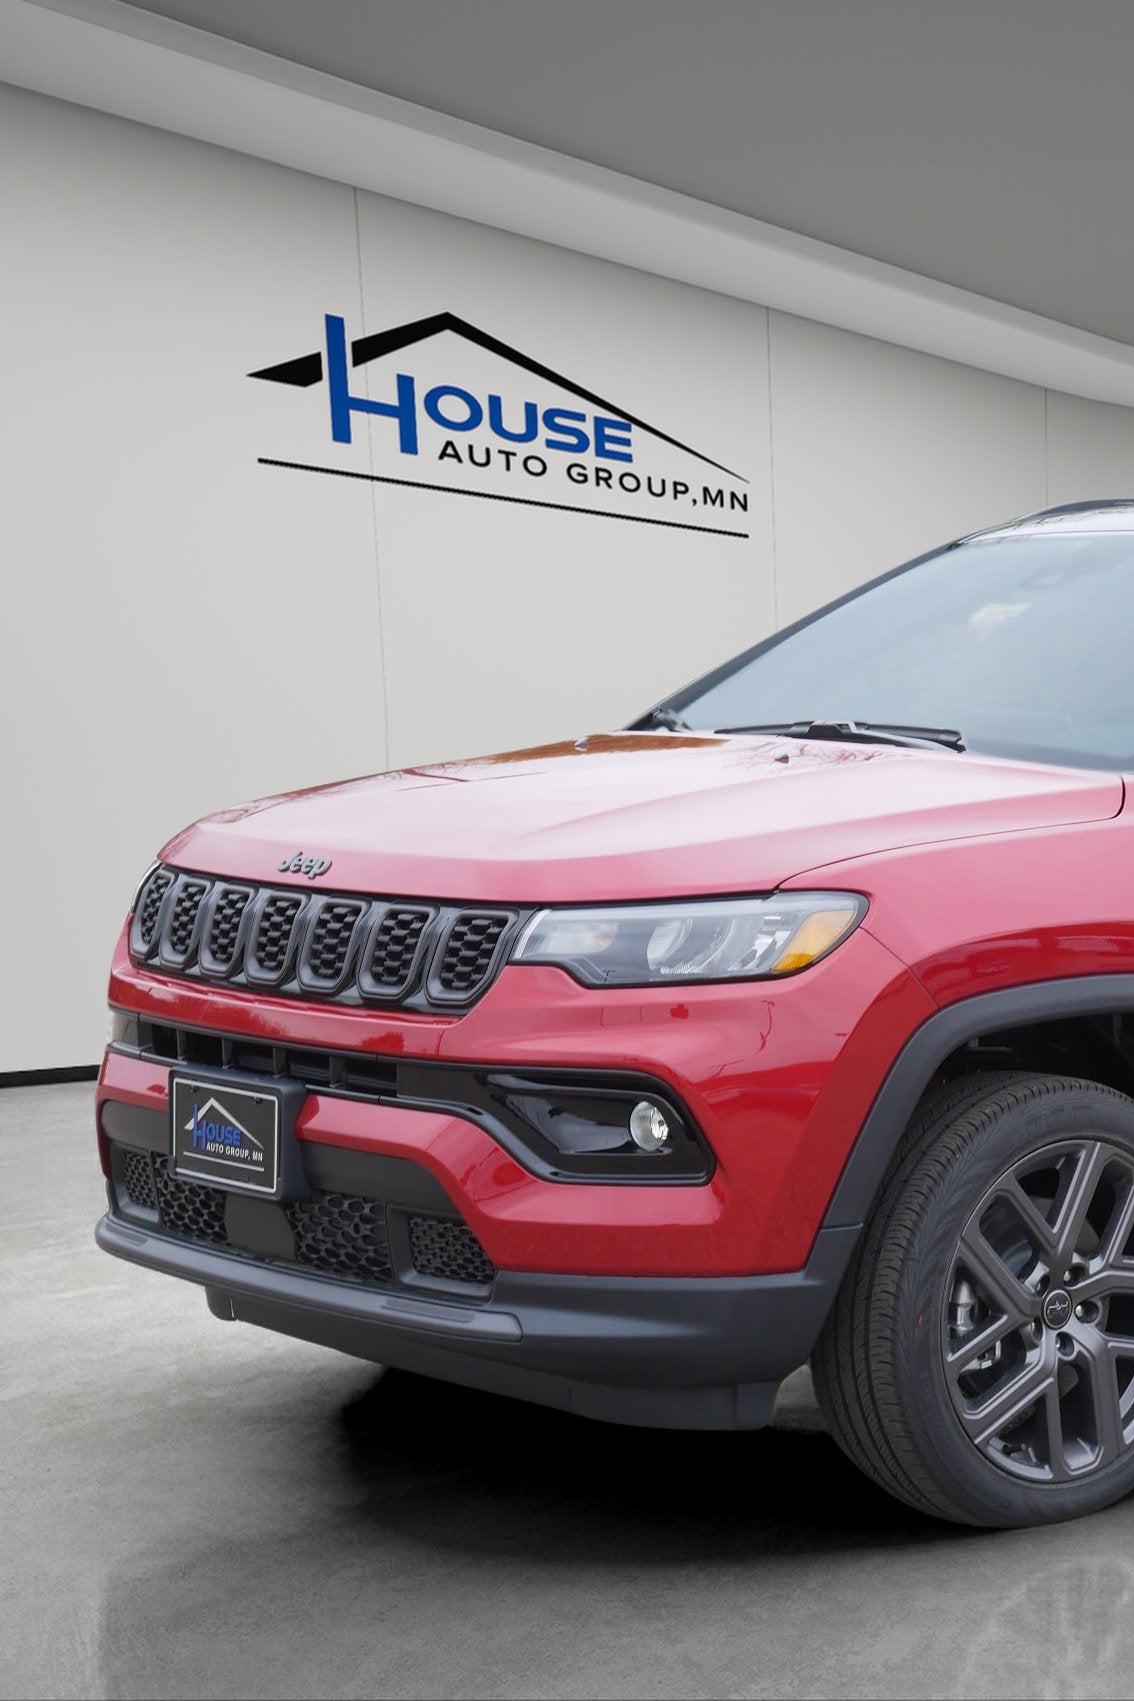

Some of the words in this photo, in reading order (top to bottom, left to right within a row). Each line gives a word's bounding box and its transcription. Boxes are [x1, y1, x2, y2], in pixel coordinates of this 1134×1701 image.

[325, 314, 633, 463] HOUSE
[438, 440, 547, 476] AUTO
[276, 851, 332, 879] Jeep
[193, 1103, 242, 1150] HOUSE
[206, 1142, 223, 1154] AUTO
[252, 1150, 263, 1161] MN
